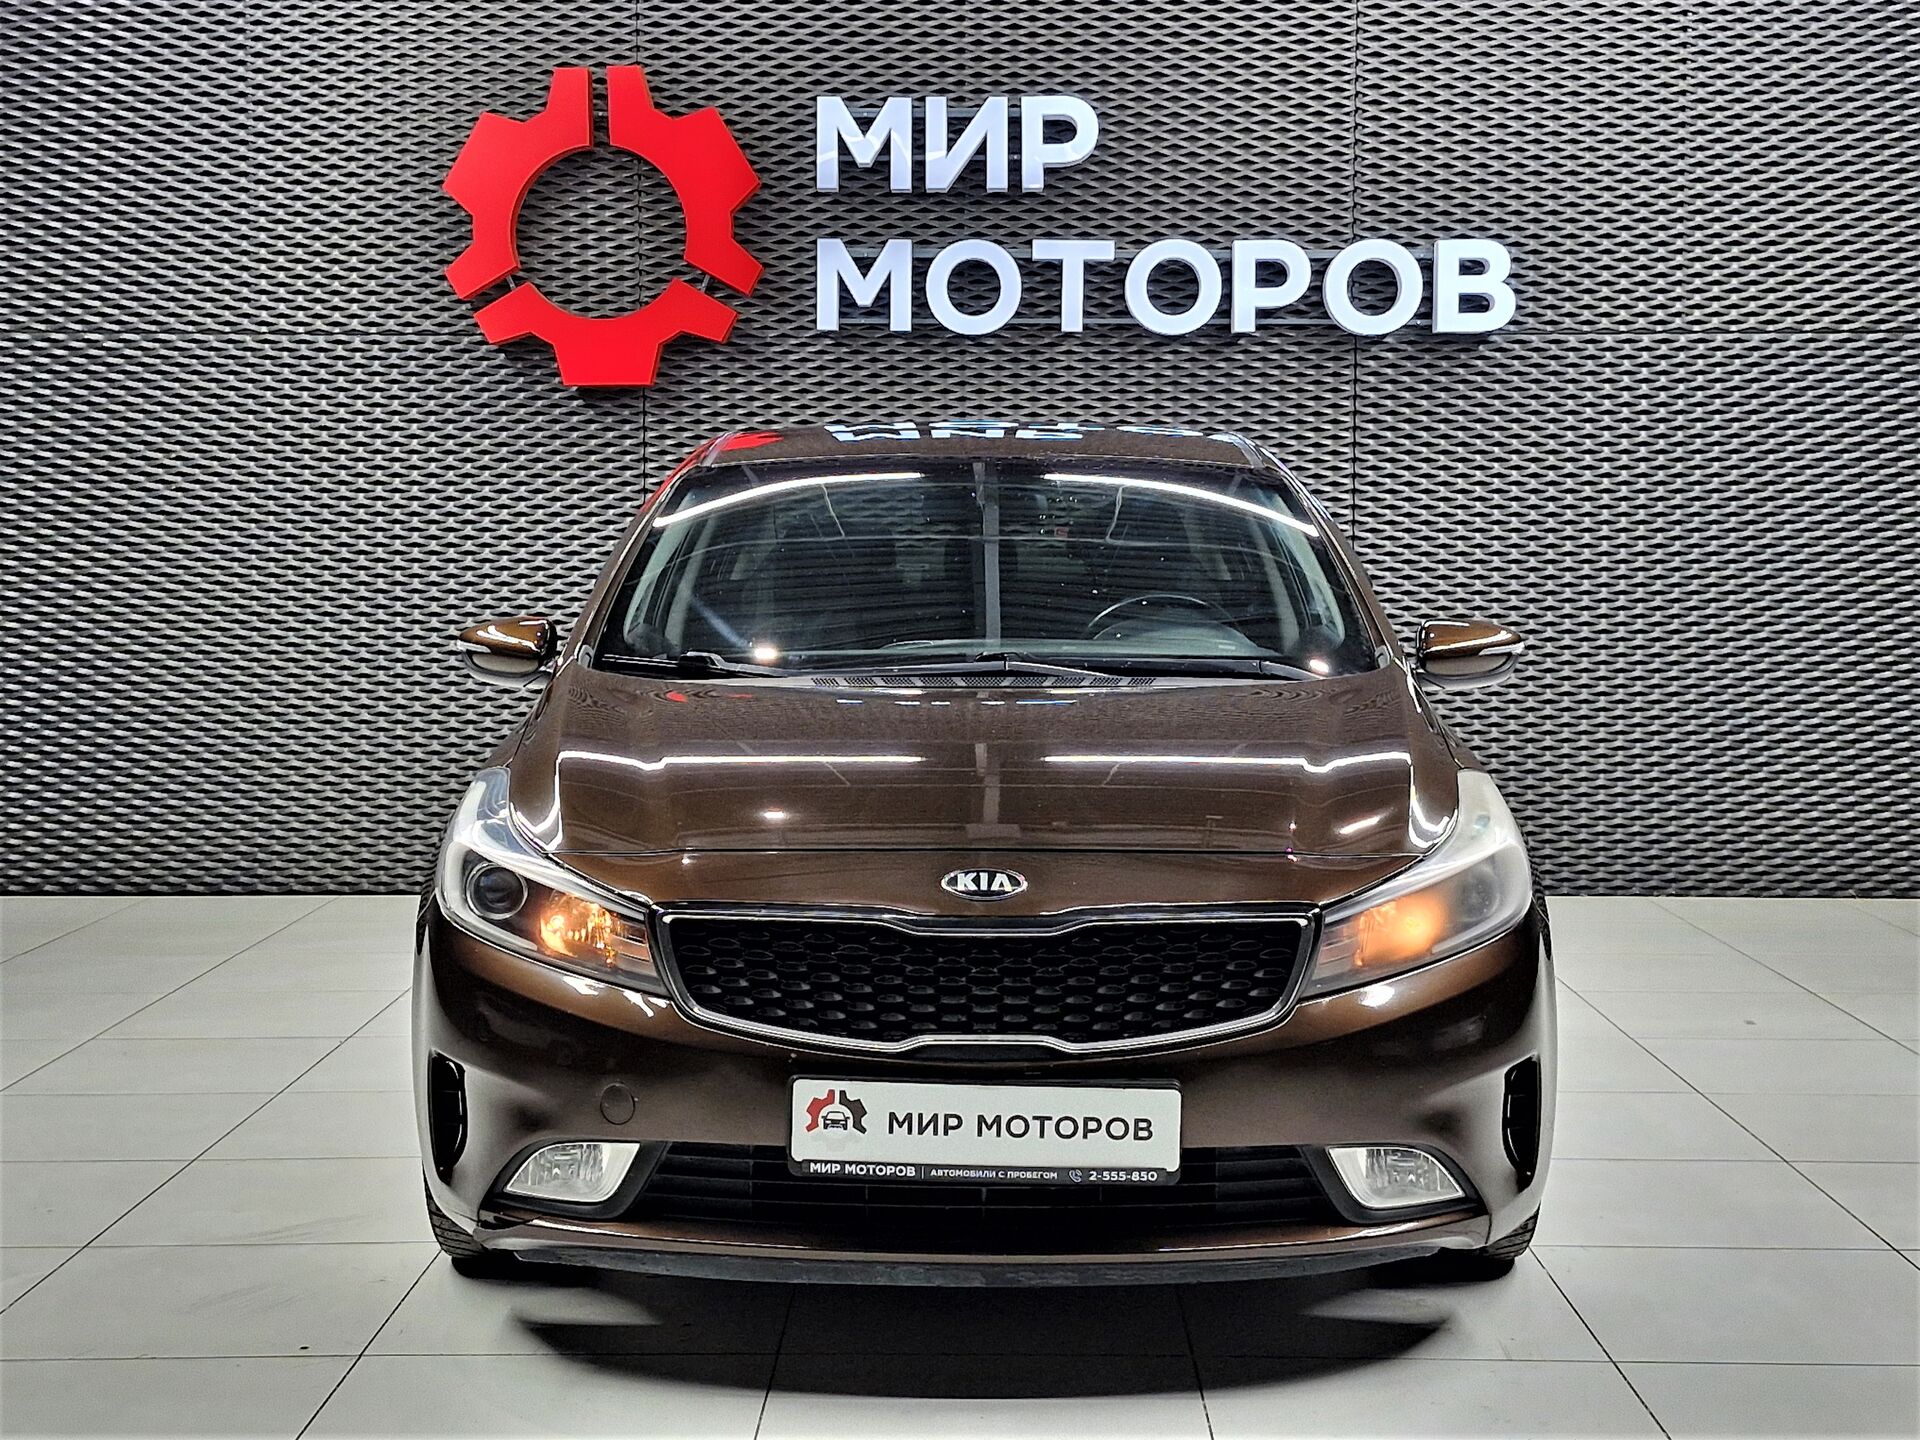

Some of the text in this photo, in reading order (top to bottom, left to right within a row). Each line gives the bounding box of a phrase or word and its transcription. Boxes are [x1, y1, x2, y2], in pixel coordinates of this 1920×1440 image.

[816, 95, 1101, 193] МИР
[816, 237, 1518, 337] МОТОРОВ
[956, 872, 1013, 892] KIA
[887, 1111, 1154, 1141] МИР МОТОРОВ
[809, 1162, 1158, 1182] МИР МОТОРОВ АВТОМОБИЛИ С ПРОБЕГОМ 2-555-850
